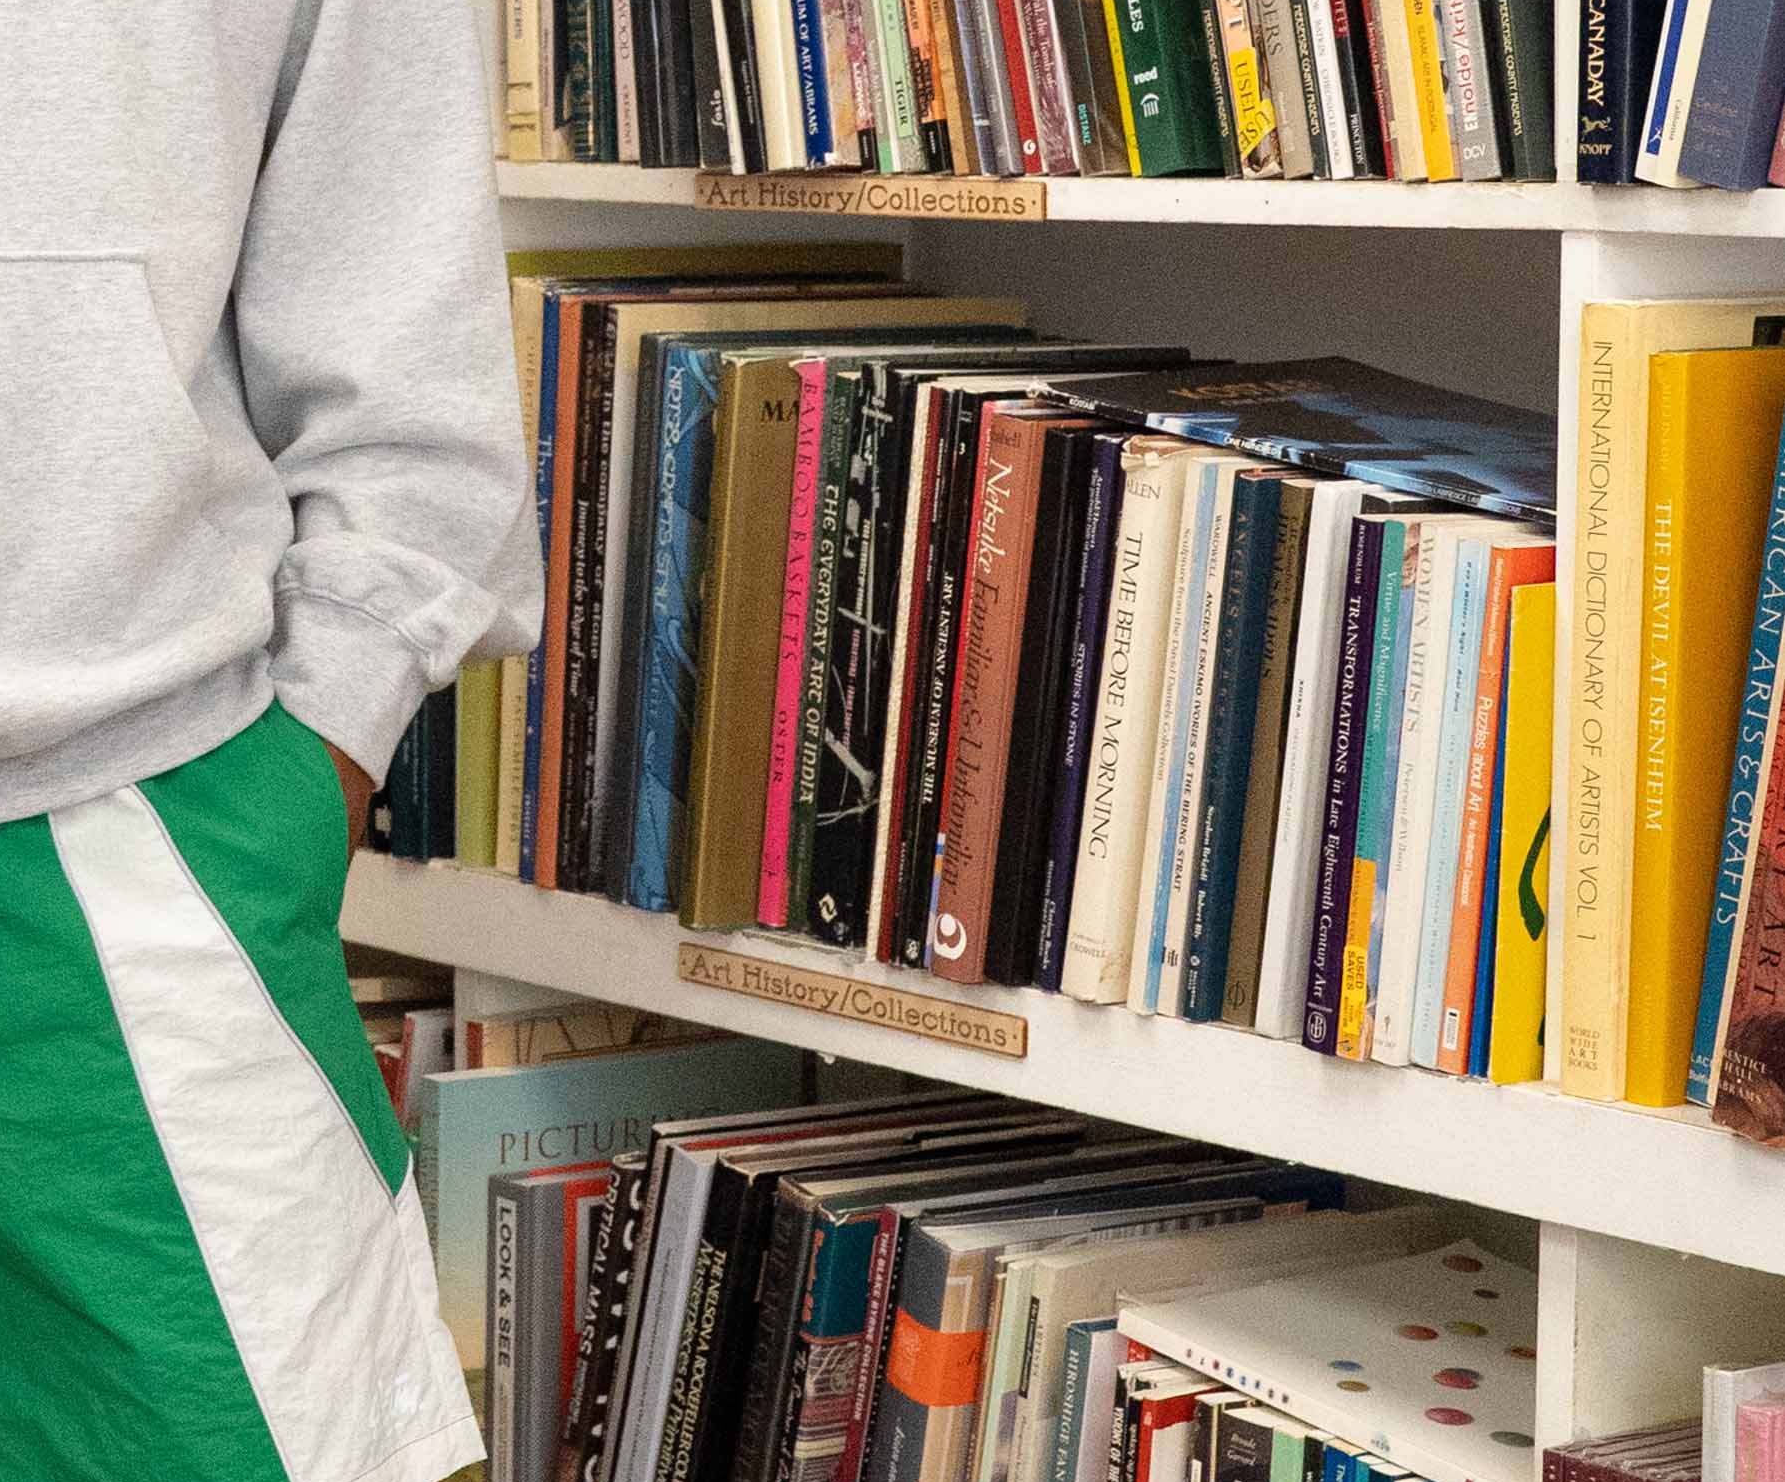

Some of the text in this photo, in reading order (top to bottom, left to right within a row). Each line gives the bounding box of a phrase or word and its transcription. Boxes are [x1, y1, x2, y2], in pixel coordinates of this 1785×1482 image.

[798, 23, 812, 43] OF
[800, 45, 819, 136] ART/ABRAMS
[704, 178, 1027, 217] Art History/Collections
[1586, 340, 1614, 542] INTERNATIONAL
[798, 485, 840, 807] THE EVERYDAY ART OF INDIA
[1406, 535, 1436, 734] WOMEN ARTISTS
[1583, 550, 1609, 710] DICTIONARY
[1644, 499, 1673, 832] THE DEVIL AT ISENHEIM
[922, 571, 955, 805] THE MUSEUM OF ANCIENT ART
[1086, 530, 1145, 860] TIME BEFORE MORNING
[1581, 718, 1603, 756] OF
[1311, 523, 1367, 999] ROSENBLUM TRANSFORMATIONS in Late Eighteenth Century Art
[1467, 695, 1494, 812] Puzzles about Art
[1579, 764, 1602, 856] ARTISTS
[1344, 949, 1356, 991] SAVES
[1354, 954, 1366, 990] USED
[1575, 932, 1597, 942] 1
[691, 951, 1008, 1048] Art History/Collections
[496, 1204, 513, 1368] LOOK & SEE
[578, 1170, 621, 1355] CRITICAL MASS
[1055, 1350, 1081, 1440] HIROSHIGE
[1052, 1445, 1068, 1479] FAN
